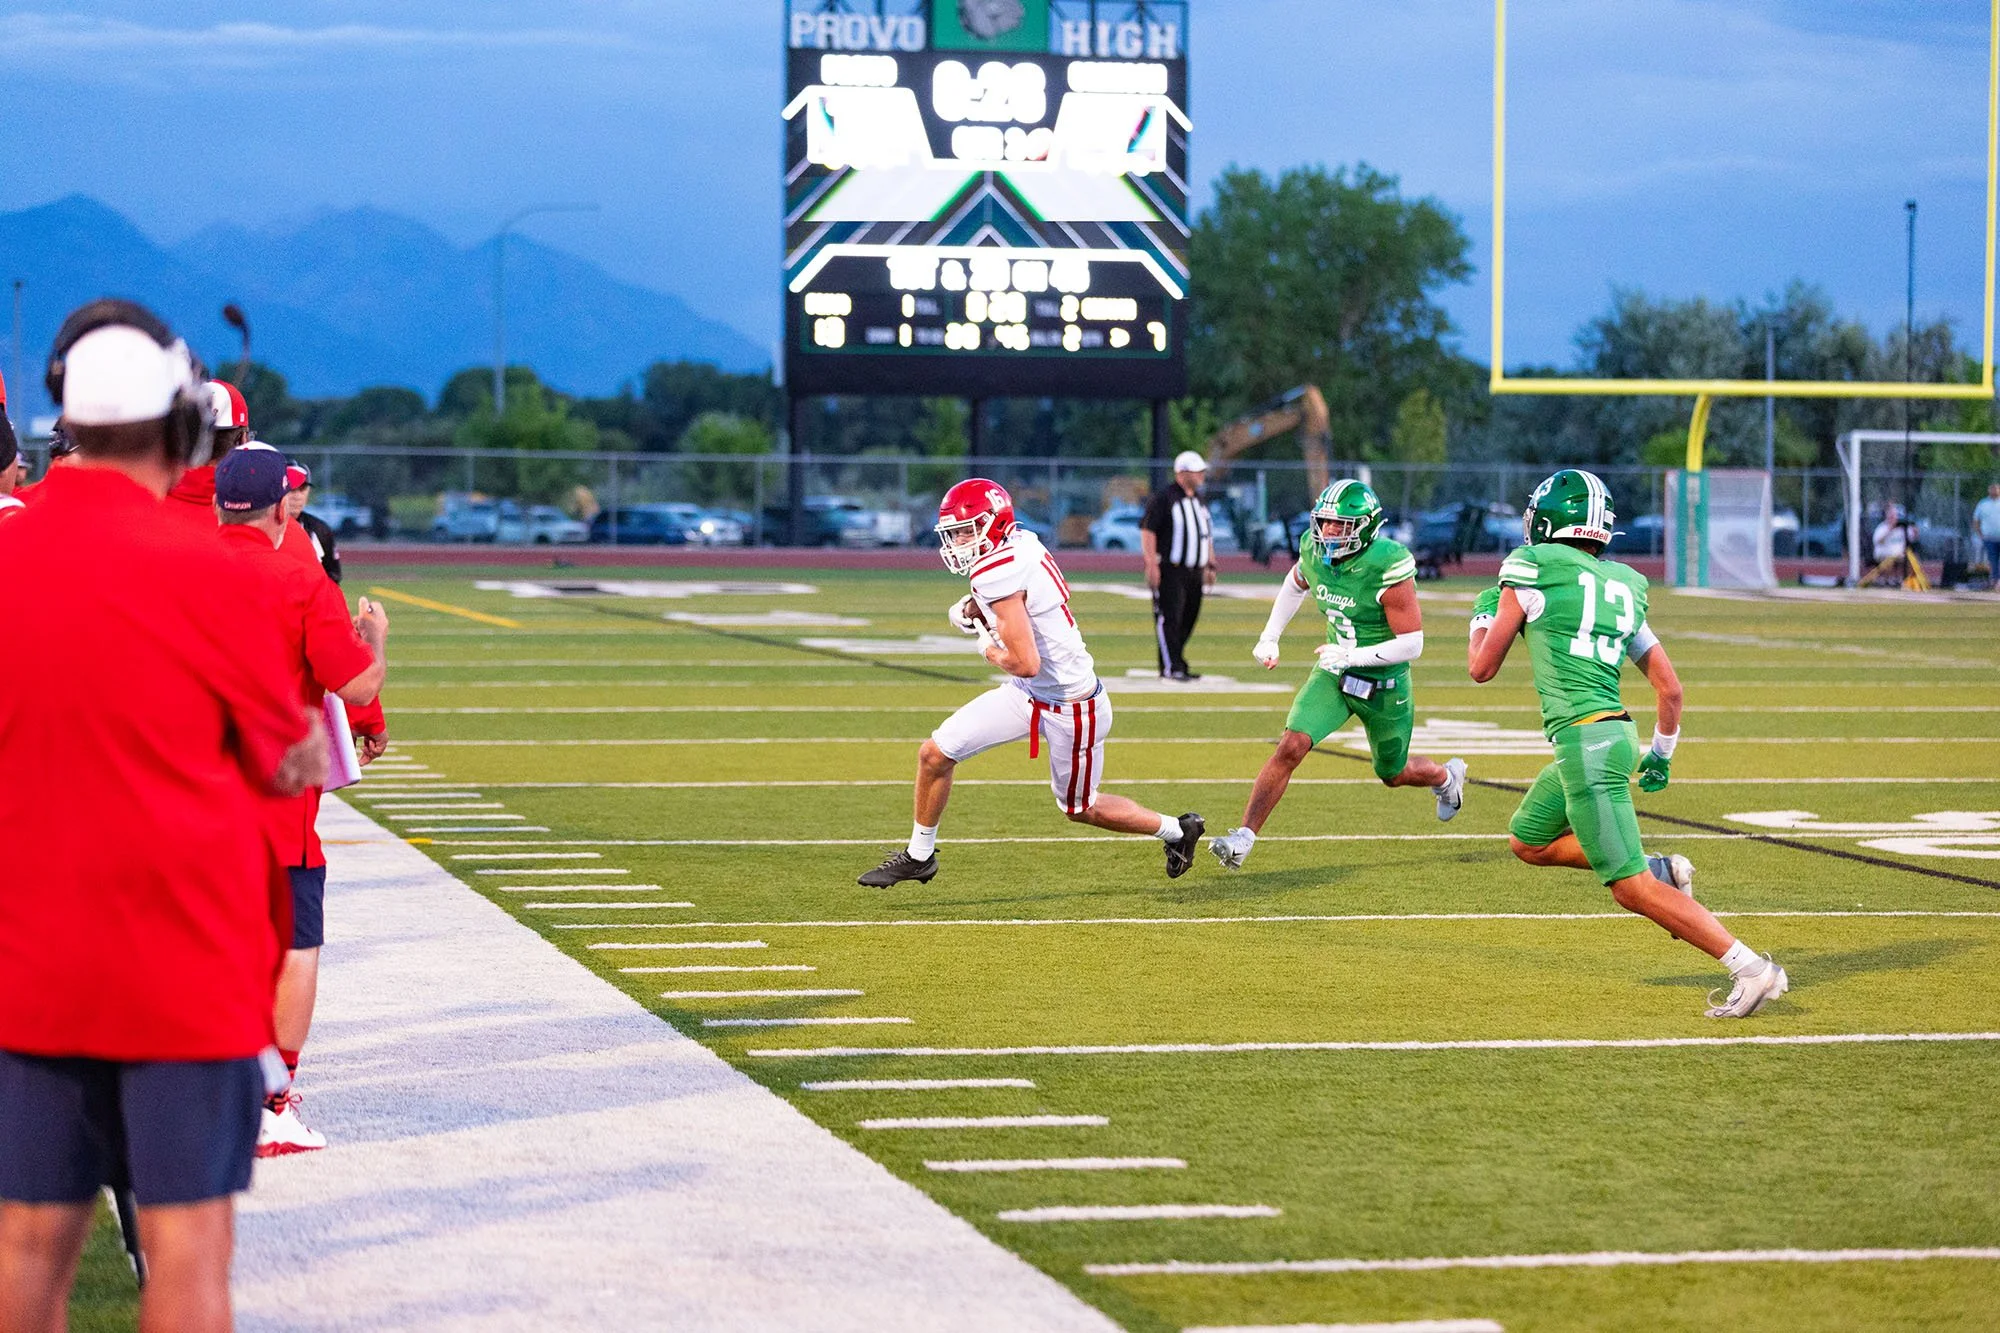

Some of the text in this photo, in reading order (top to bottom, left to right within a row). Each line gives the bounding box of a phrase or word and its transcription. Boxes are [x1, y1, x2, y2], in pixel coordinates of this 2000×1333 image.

[789, 11, 1179, 59] PROVO HIGH
[985, 489, 1006, 512] 16
[1573, 527, 1609, 541] Riddell
[1316, 584, 1356, 610] Dawgs
[1569, 571, 1634, 665] 13
